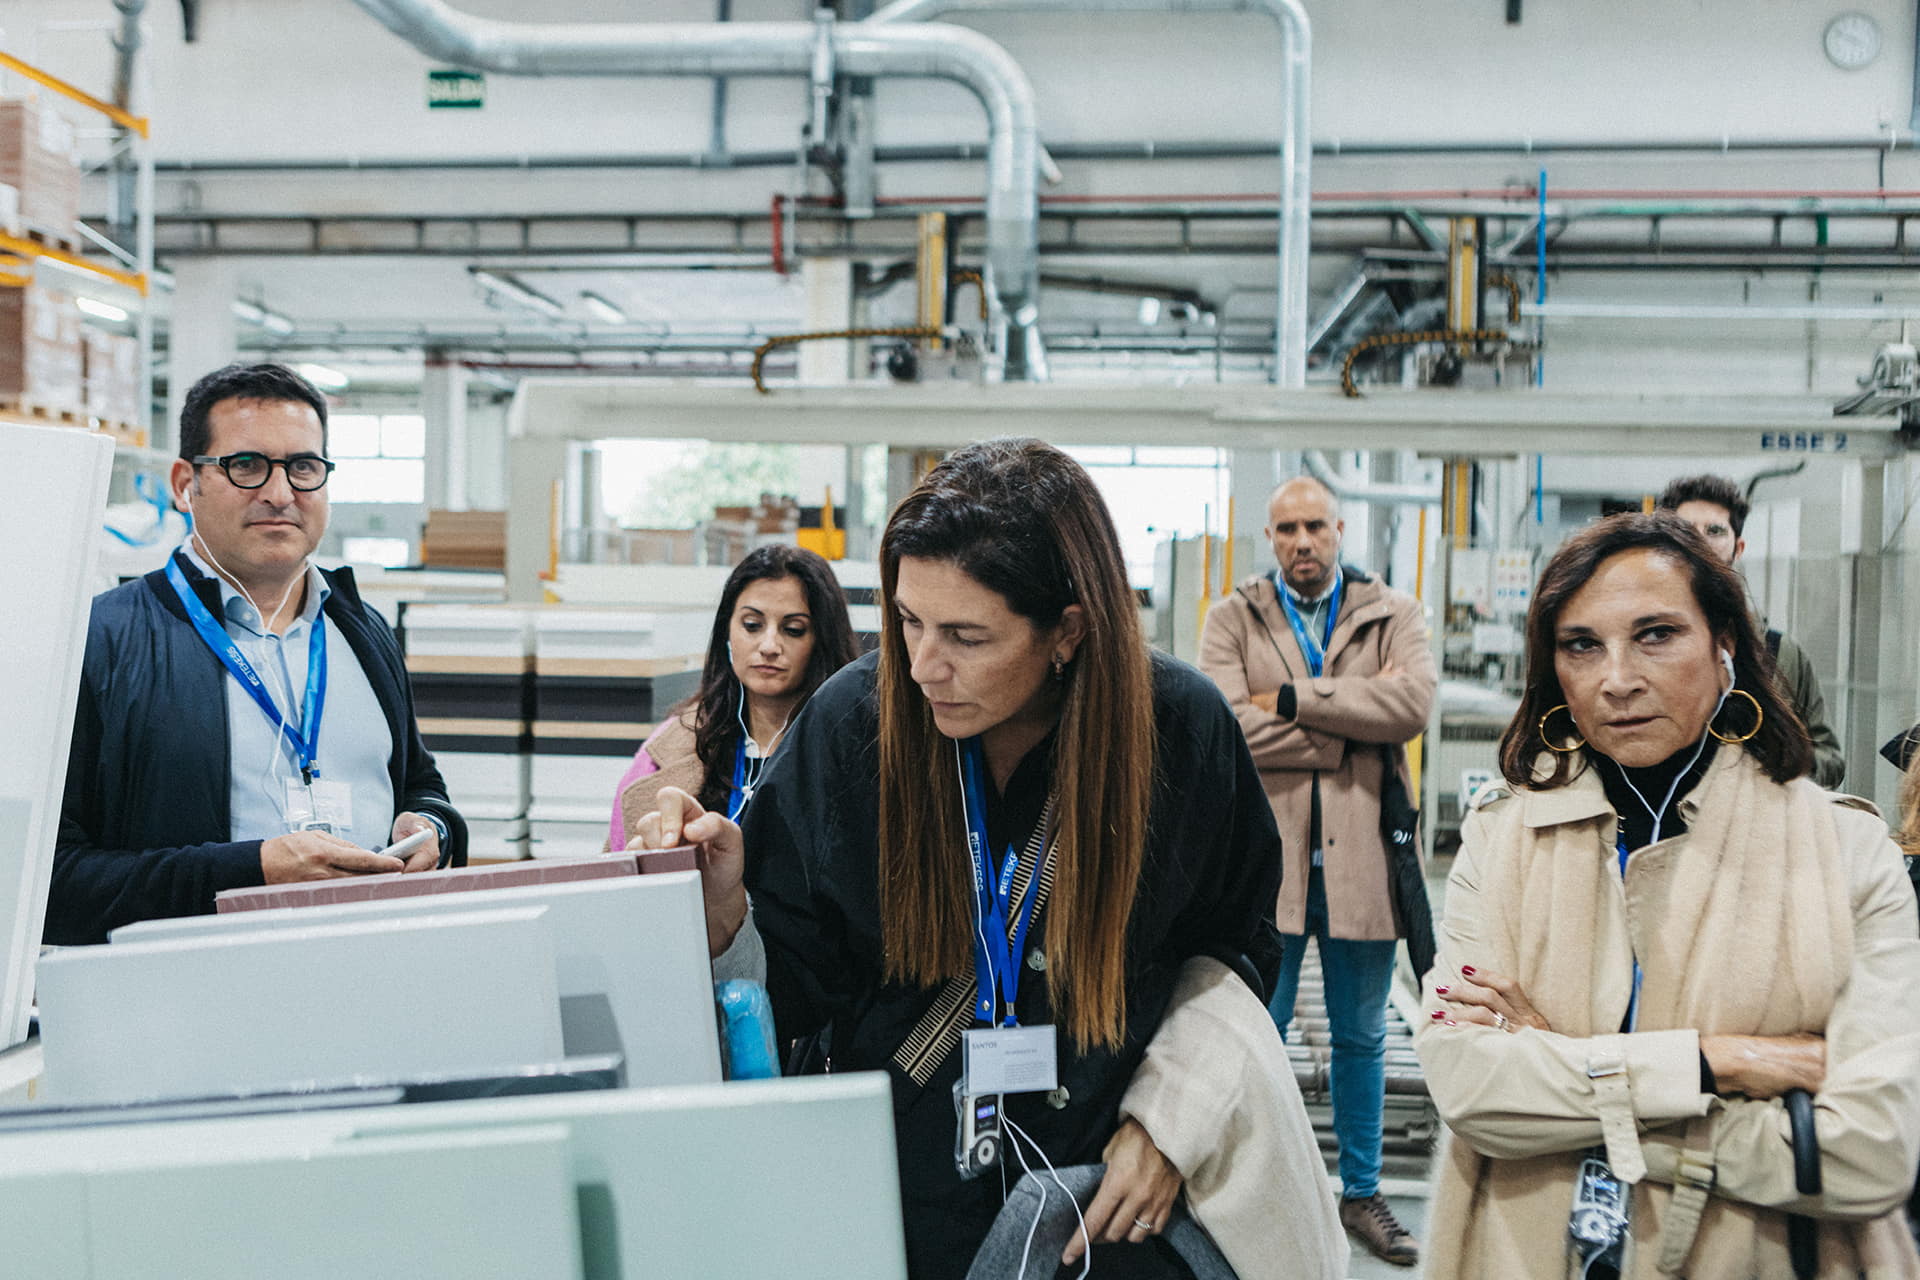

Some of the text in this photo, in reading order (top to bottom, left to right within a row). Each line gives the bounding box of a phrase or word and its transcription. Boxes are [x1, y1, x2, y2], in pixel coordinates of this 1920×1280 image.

[1761, 431, 1847, 450] ESSE 2
[972, 1041, 998, 1050] SANTOS
